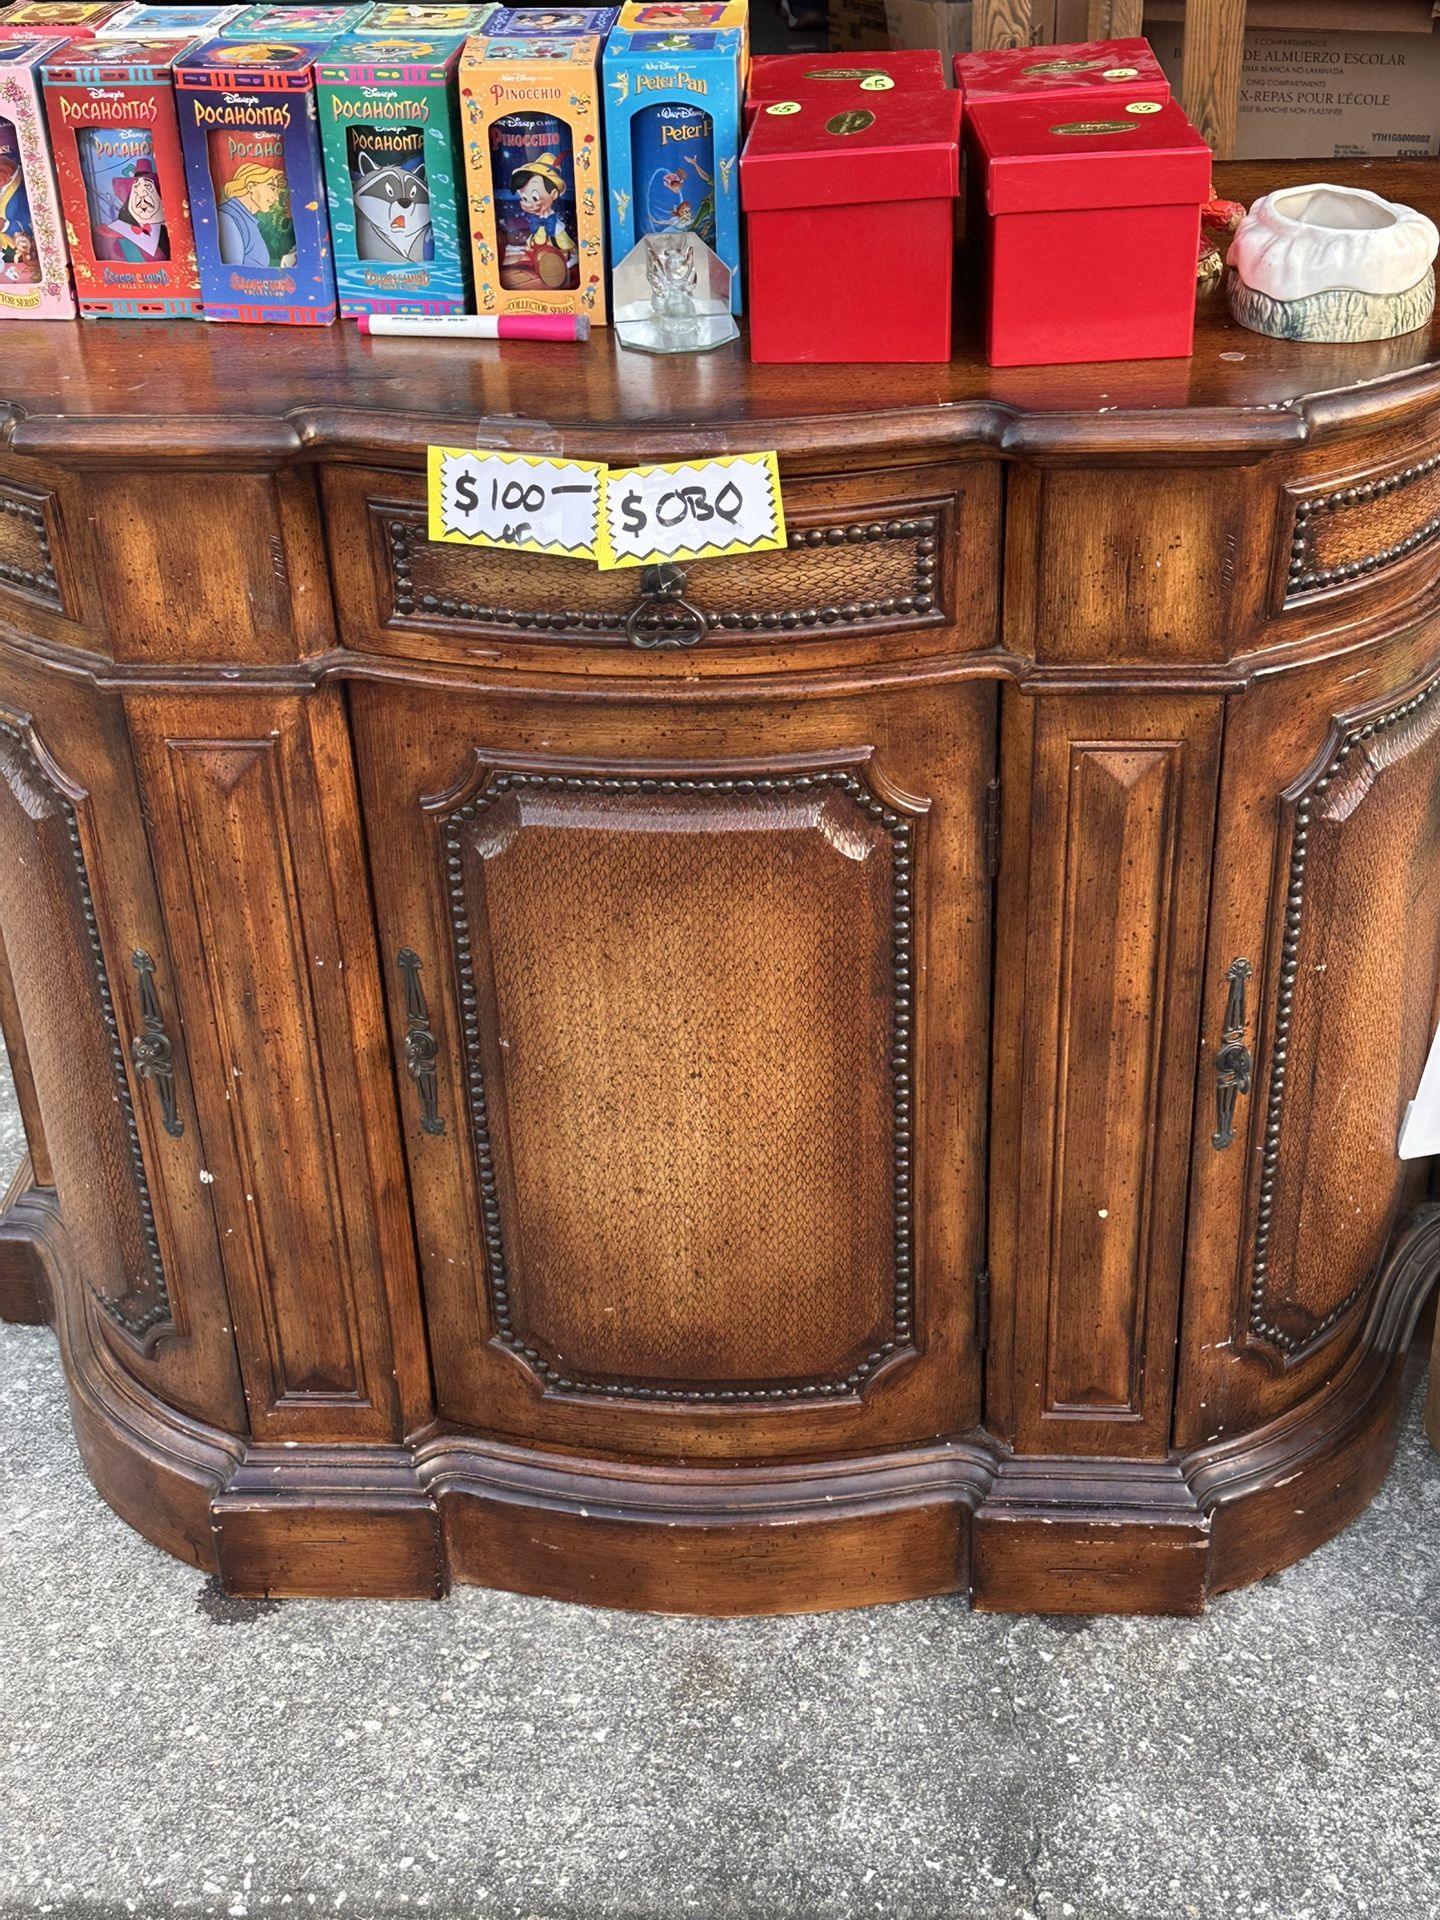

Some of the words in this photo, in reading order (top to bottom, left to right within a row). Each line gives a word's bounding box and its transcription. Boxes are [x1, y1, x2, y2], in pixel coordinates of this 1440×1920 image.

[658, 61, 680, 71] Disney
[1244, 50, 1262, 63] DE
[1264, 51, 1340, 65] ALMUERZO
[1344, 52, 1406, 66] ESCOLAR
[635, 74, 675, 96] Peter
[676, 72, 708, 96] Pan
[87, 87, 125, 101] Disney's
[221, 92, 259, 107] Disney's
[360, 86, 398, 101] Disney's
[1239, 90, 1293, 103] X-REPAS
[1297, 92, 1334, 104] POUR
[60, 96, 158, 123] POCAHONTAS
[194, 99, 291, 129] POCAHONTAS
[332, 94, 430, 123] POCAHONTAS
[661, 107, 680, 119] Walt
[505, 116, 535, 130] Disney
[352, 128, 425, 151] POCAHONTA
[661, 124, 702, 145] Peter
[94, 135, 152, 159] POCAHO
[228, 136, 284, 160] POCAHO
